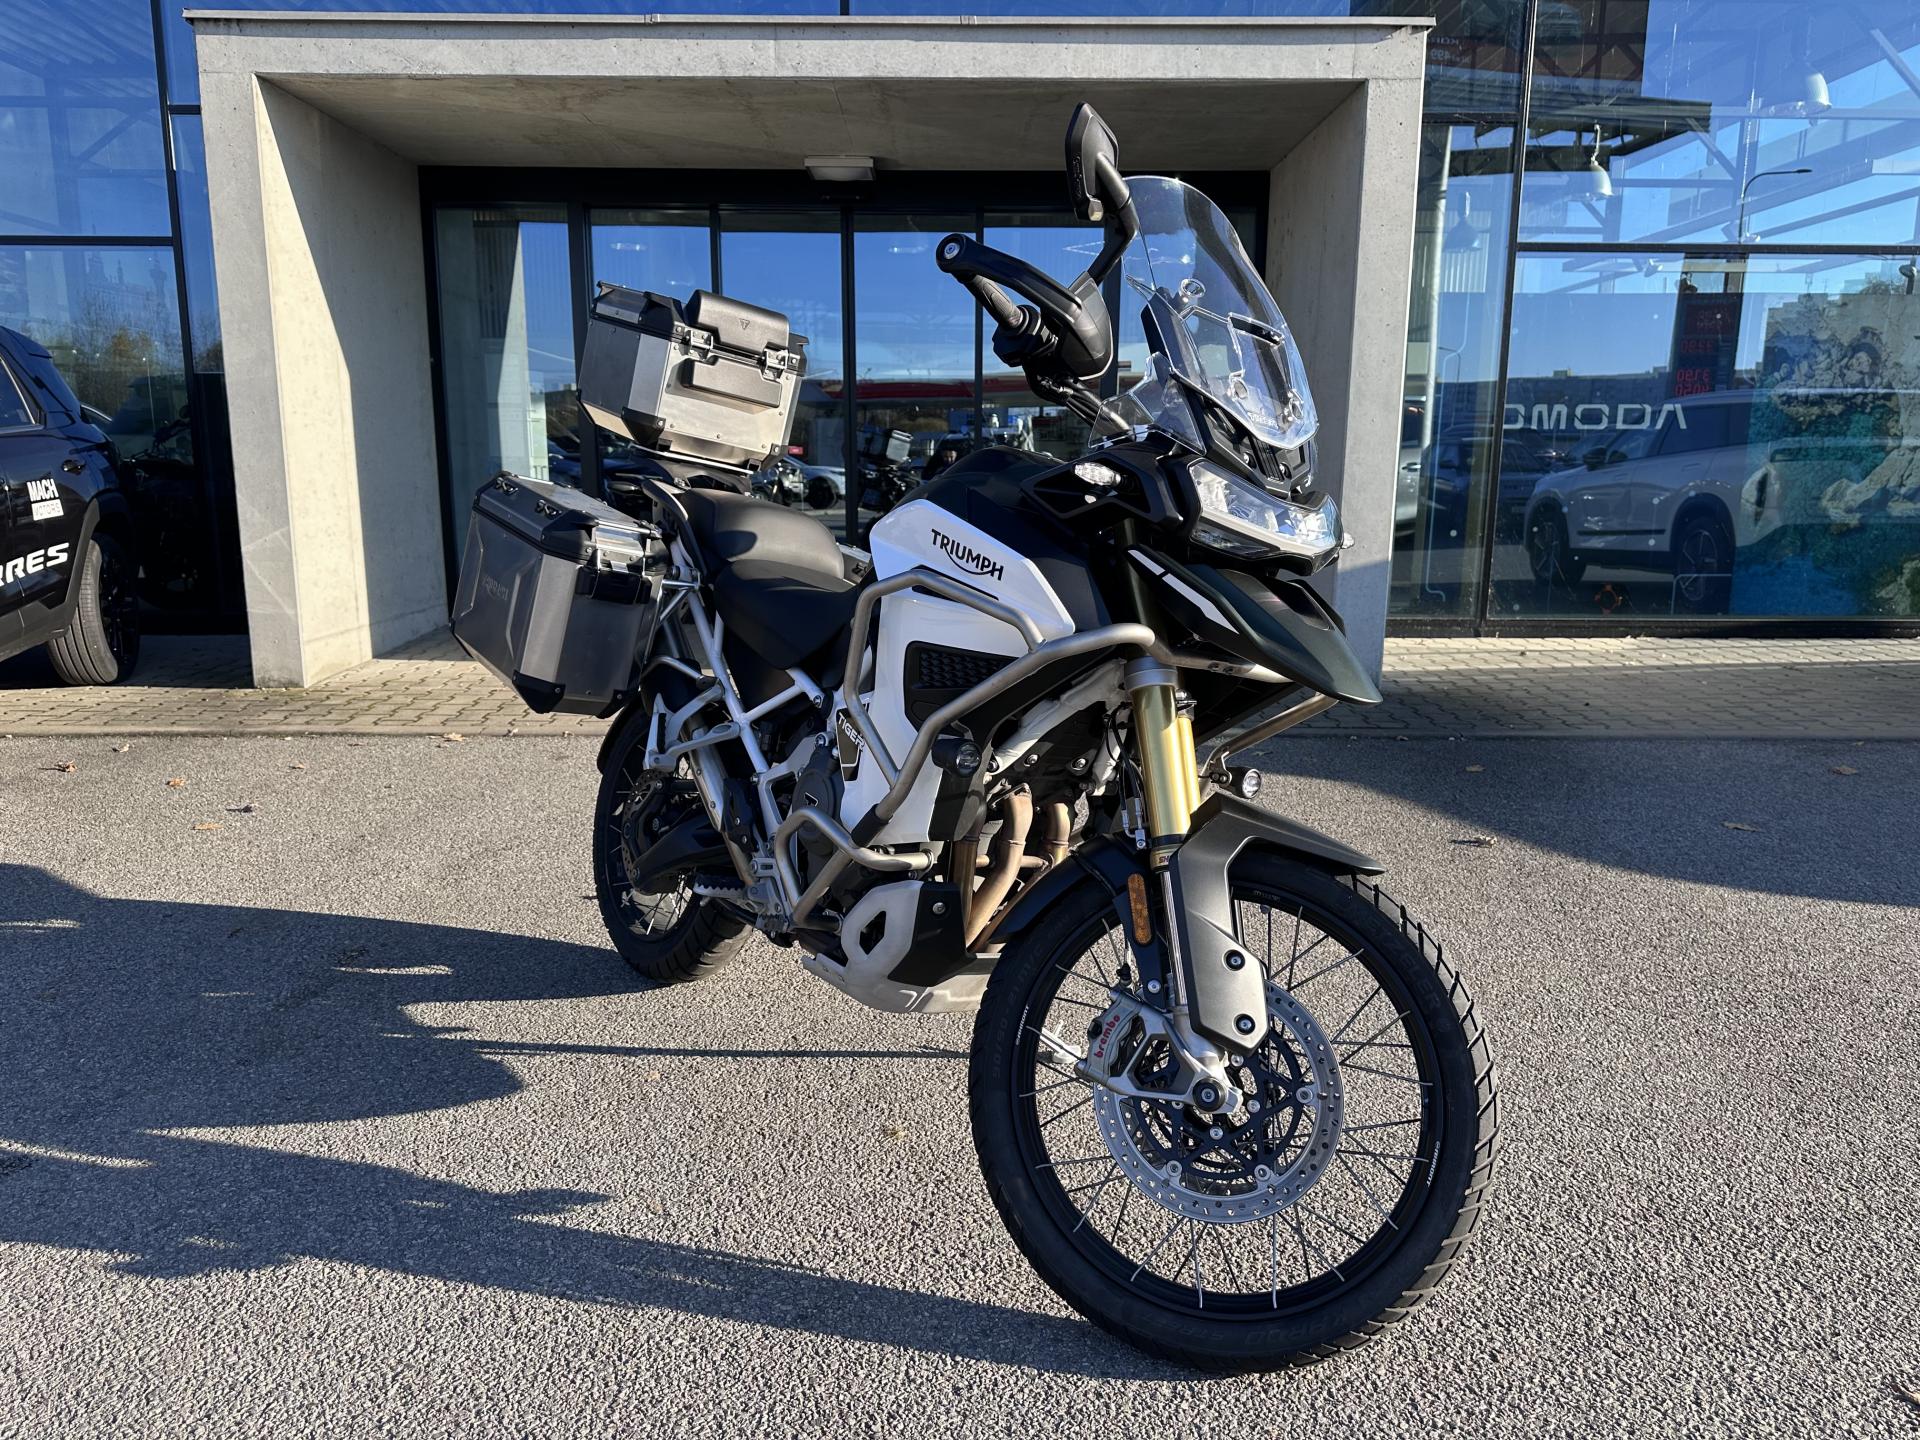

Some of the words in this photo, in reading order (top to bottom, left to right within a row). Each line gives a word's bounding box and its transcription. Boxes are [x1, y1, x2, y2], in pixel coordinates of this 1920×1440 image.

[27, 479, 59, 501] MACH
[33, 502, 61, 516] MOTORS
[0, 542, 70, 587] RES
[931, 528, 1004, 581] TRIUMPH
[838, 712, 865, 752] TIGER
[1093, 1014, 1120, 1058] brembo
